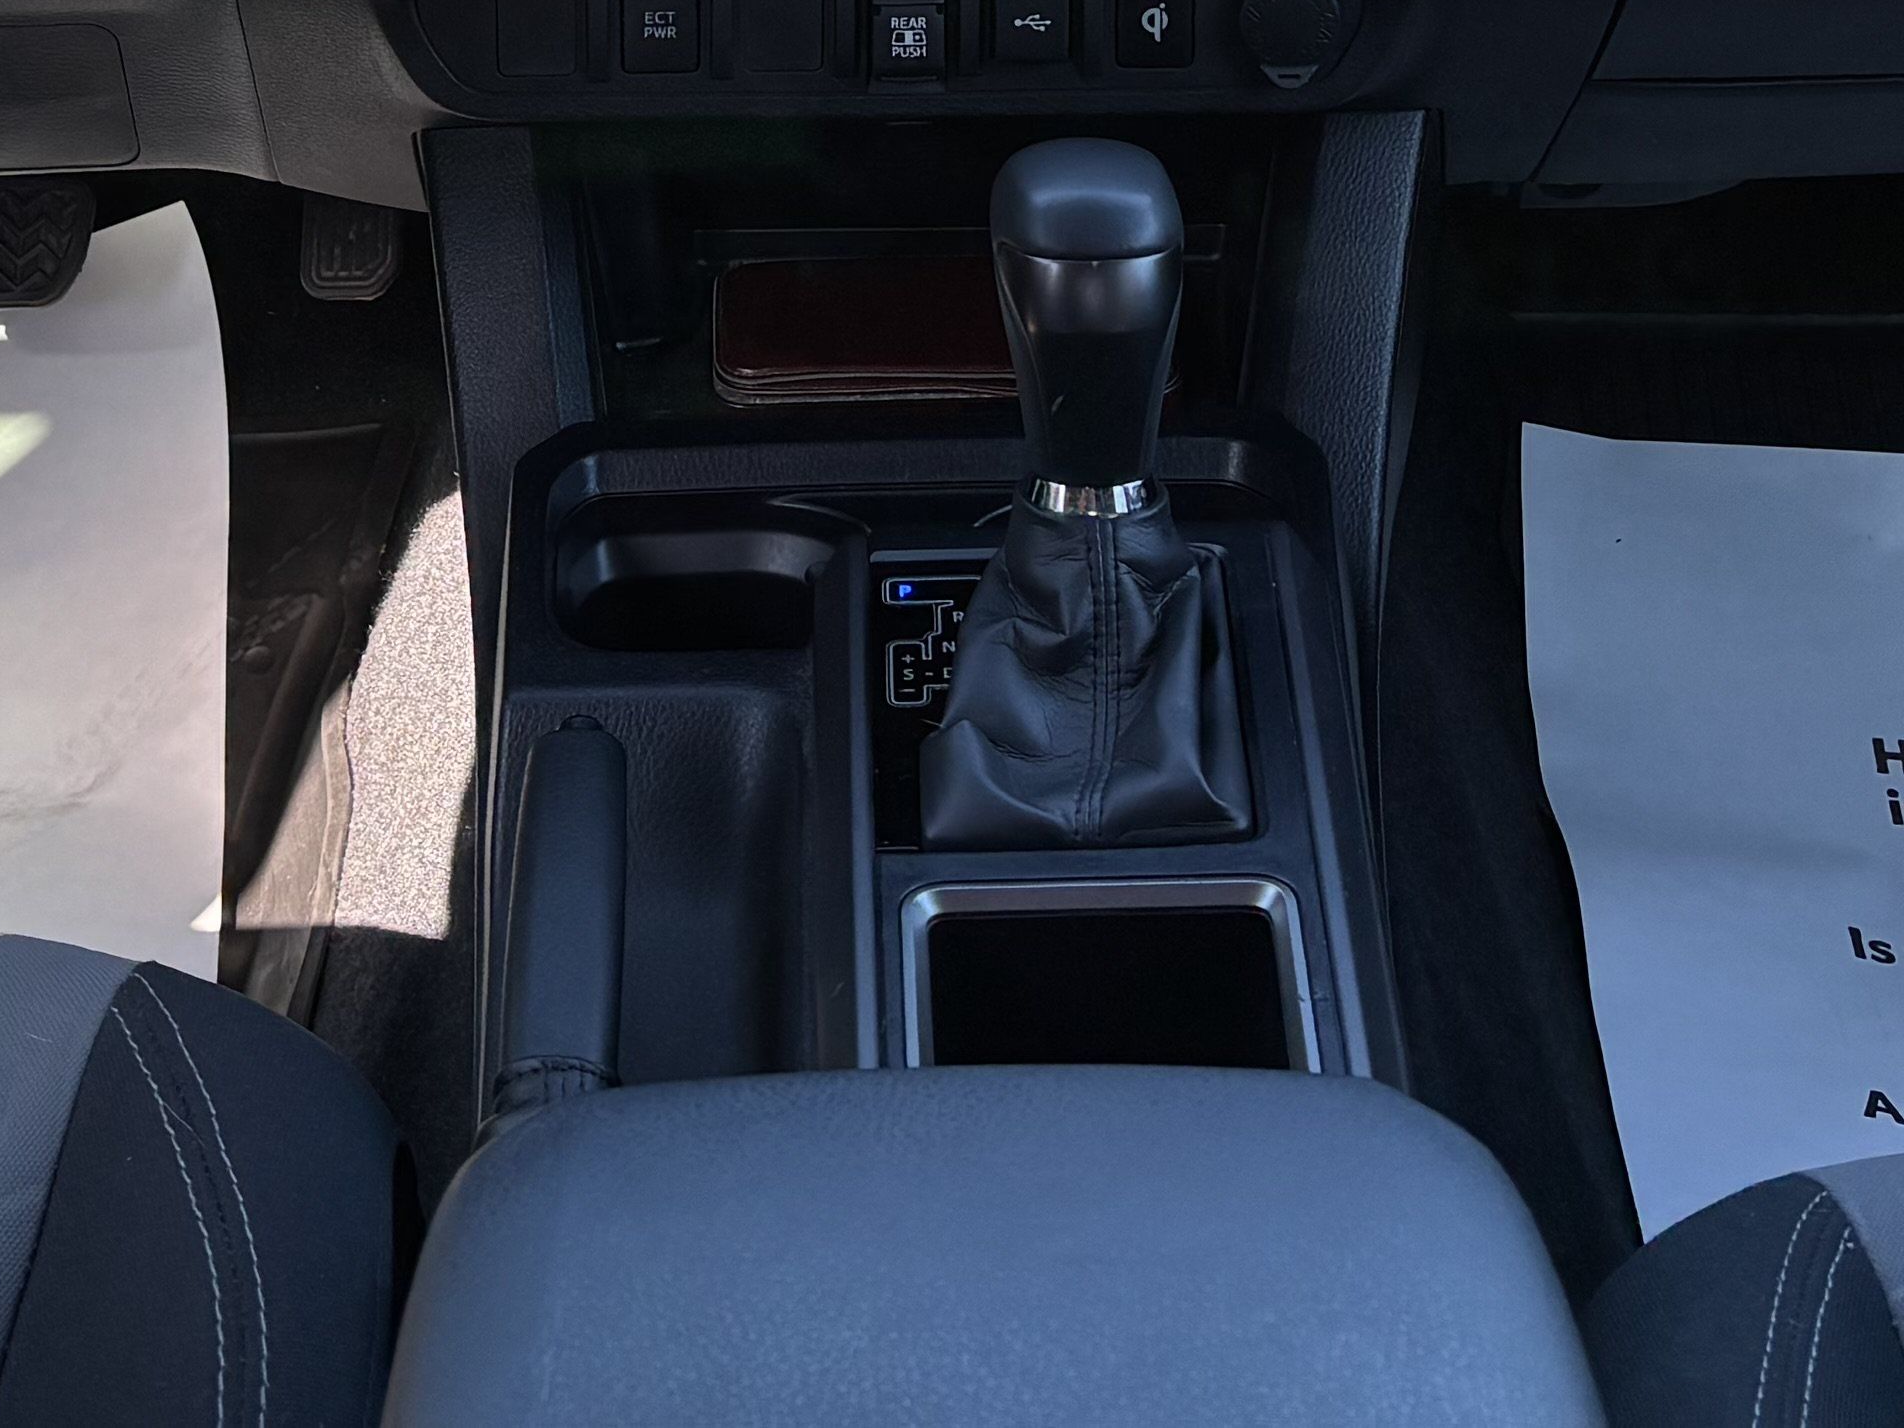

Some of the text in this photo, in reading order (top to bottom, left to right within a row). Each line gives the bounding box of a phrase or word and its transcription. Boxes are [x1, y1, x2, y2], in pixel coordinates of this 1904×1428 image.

[643, 10, 678, 24] ECT
[889, 15, 928, 31] REAR
[642, 24, 679, 40] PWR
[889, 43, 929, 60] PUSH
[898, 584, 912, 597] P
[952, 610, 964, 623] R
[941, 640, 956, 654] N
[902, 668, 915, 681] S
[1845, 923, 1896, 965] Is
